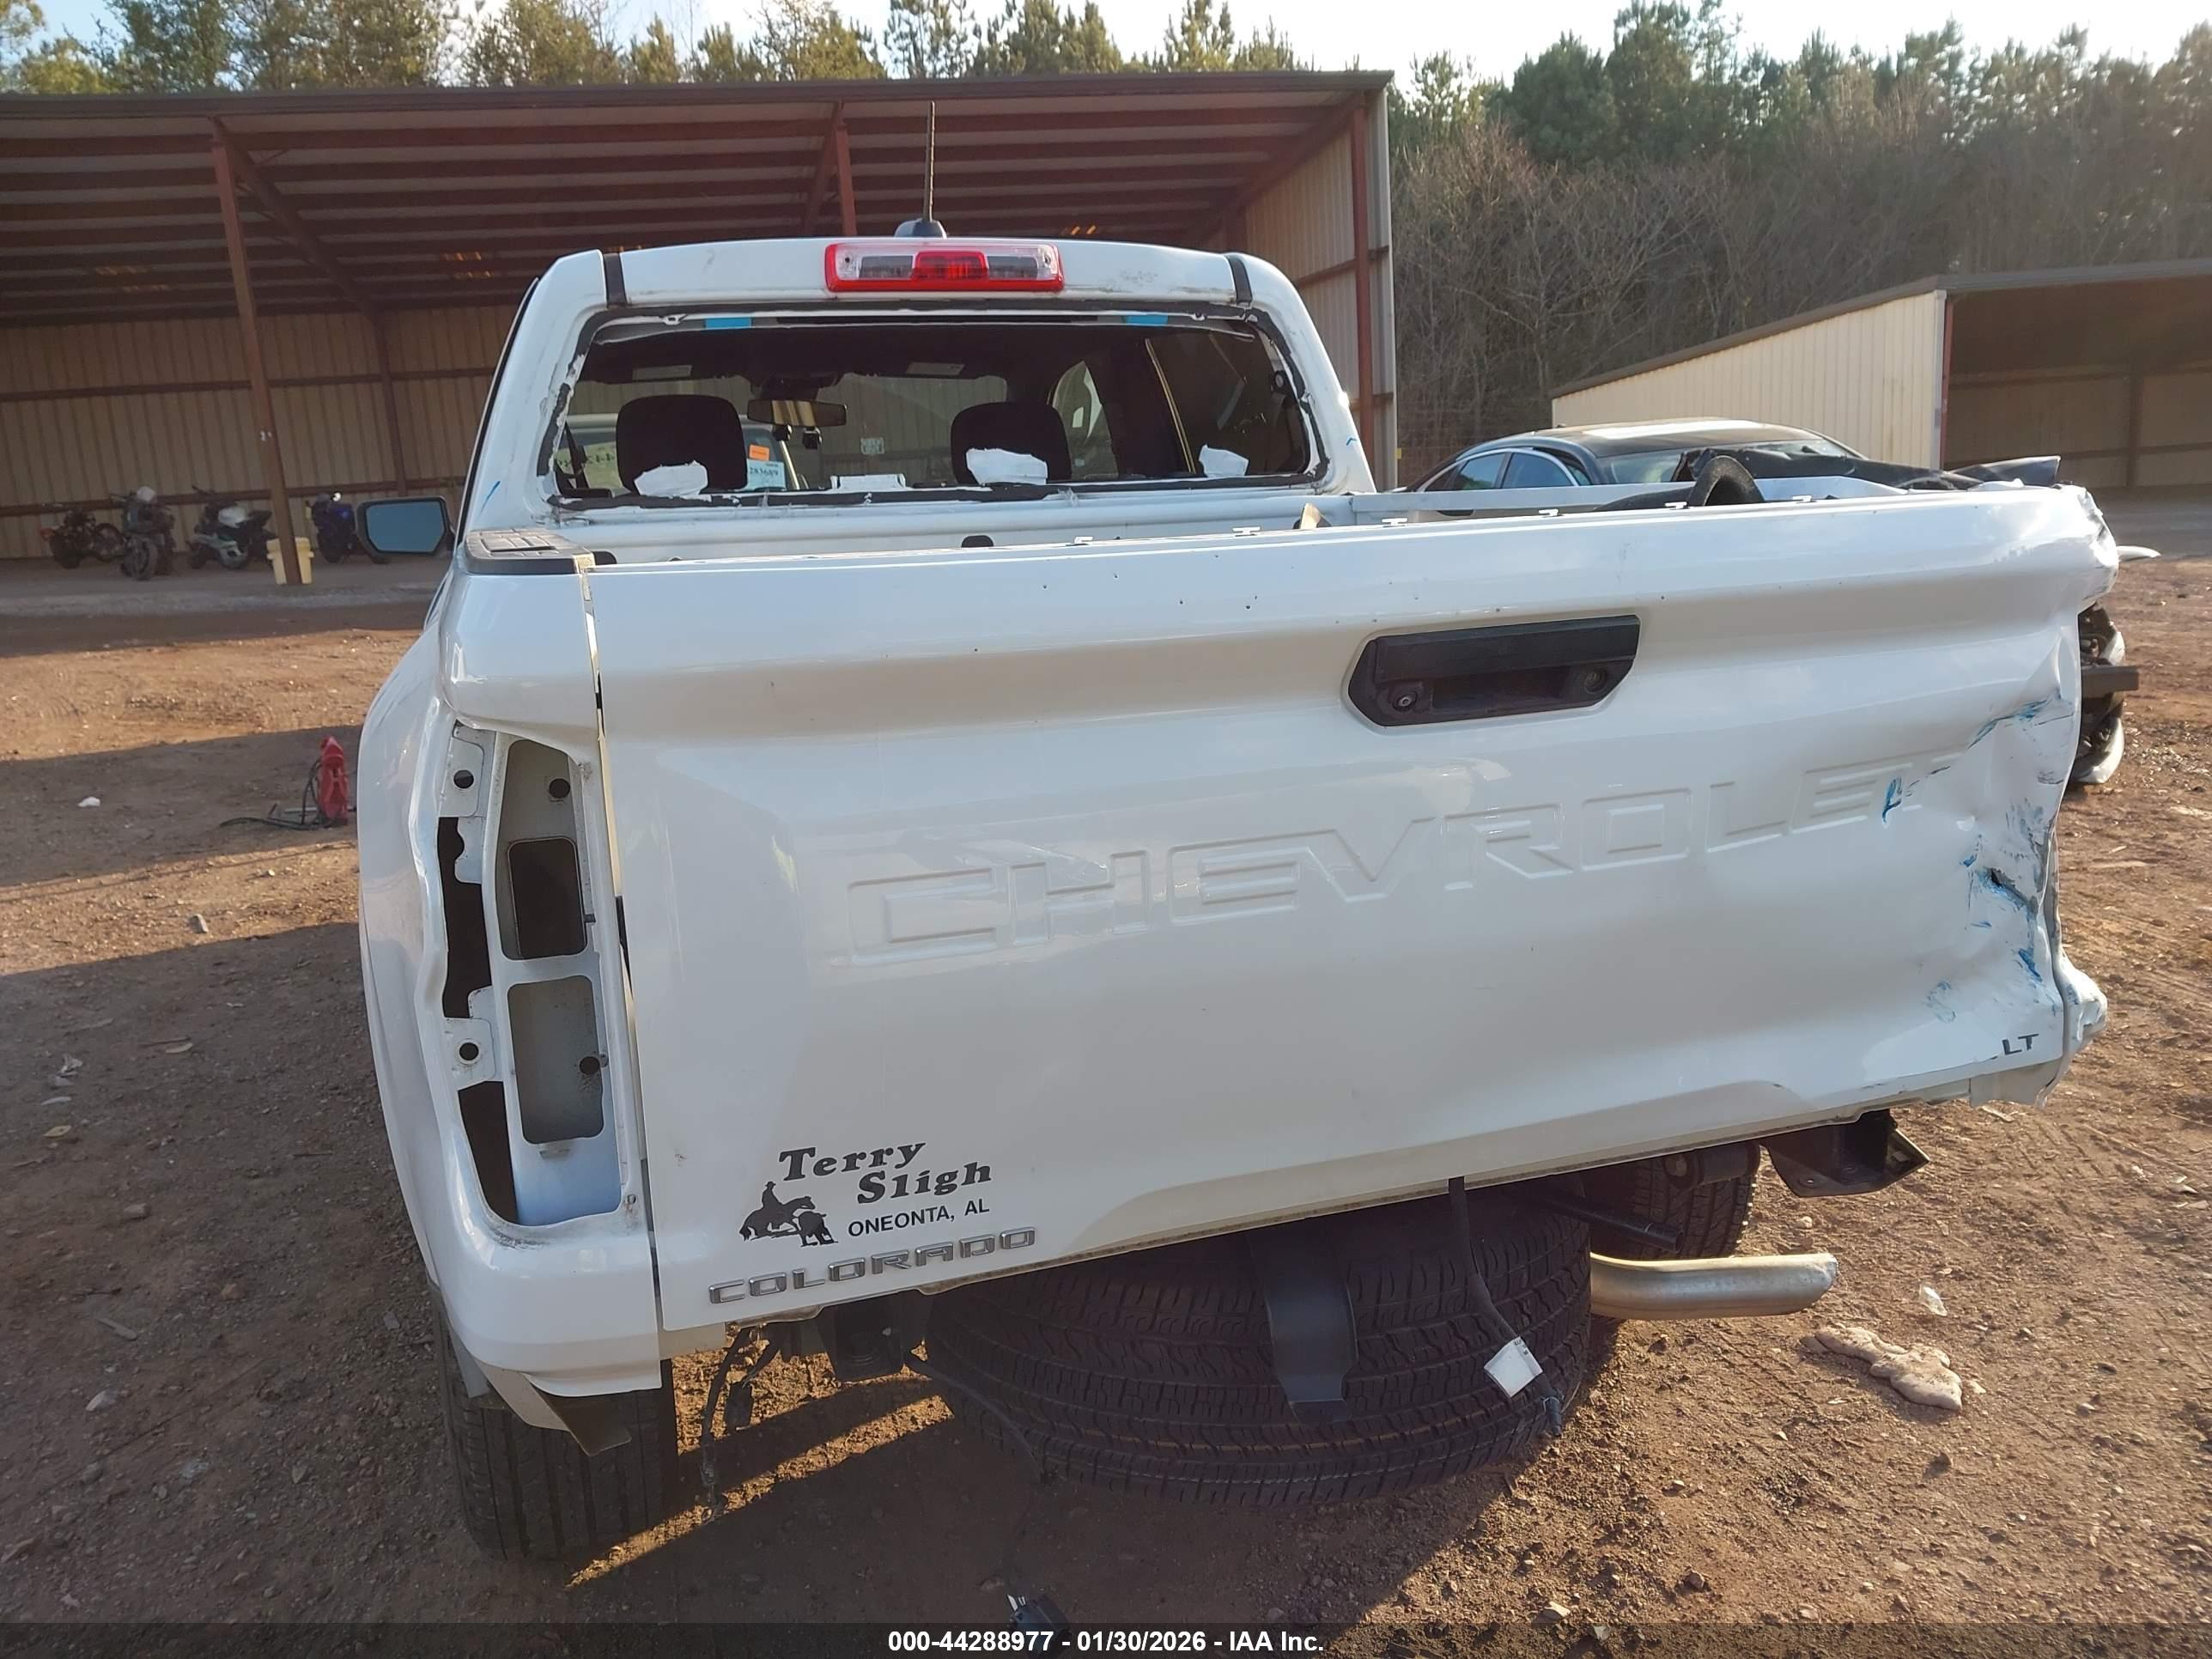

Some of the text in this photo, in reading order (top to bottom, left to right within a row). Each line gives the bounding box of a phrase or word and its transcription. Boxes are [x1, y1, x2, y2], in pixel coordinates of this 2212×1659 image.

[2002, 1033, 2039, 1055] LT
[779, 1141, 927, 1182] Terry
[858, 1161, 993, 1204] Sligh
[847, 1197, 990, 1237] ONEONTA, AL
[708, 1225, 1036, 1304] COLORADO
